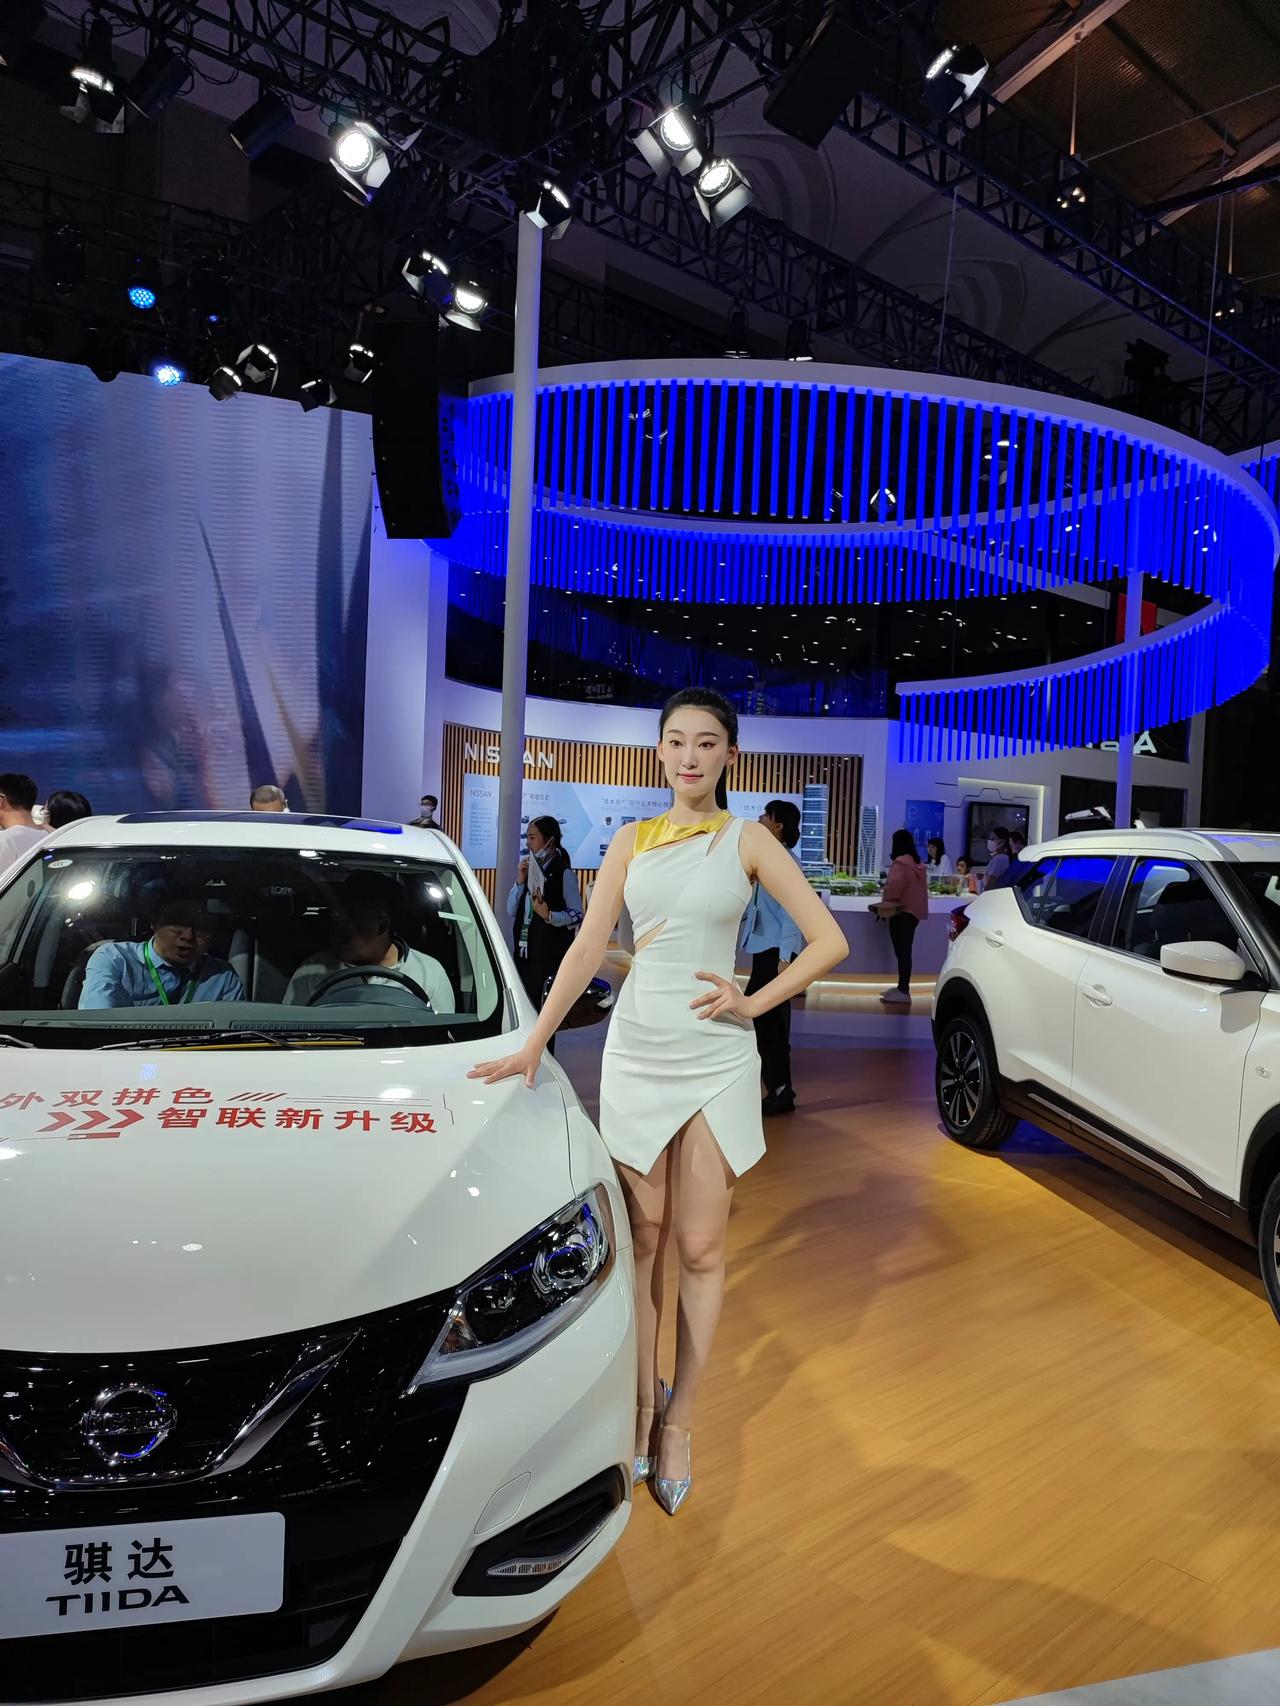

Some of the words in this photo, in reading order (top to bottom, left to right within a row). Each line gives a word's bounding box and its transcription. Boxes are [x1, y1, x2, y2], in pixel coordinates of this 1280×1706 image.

[464, 742, 554, 769] NISAN
[157, 1107, 438, 1134] 智联新升级
[64, 1537, 174, 1586] 骐达
[45, 1585, 190, 1616] TIIDA
